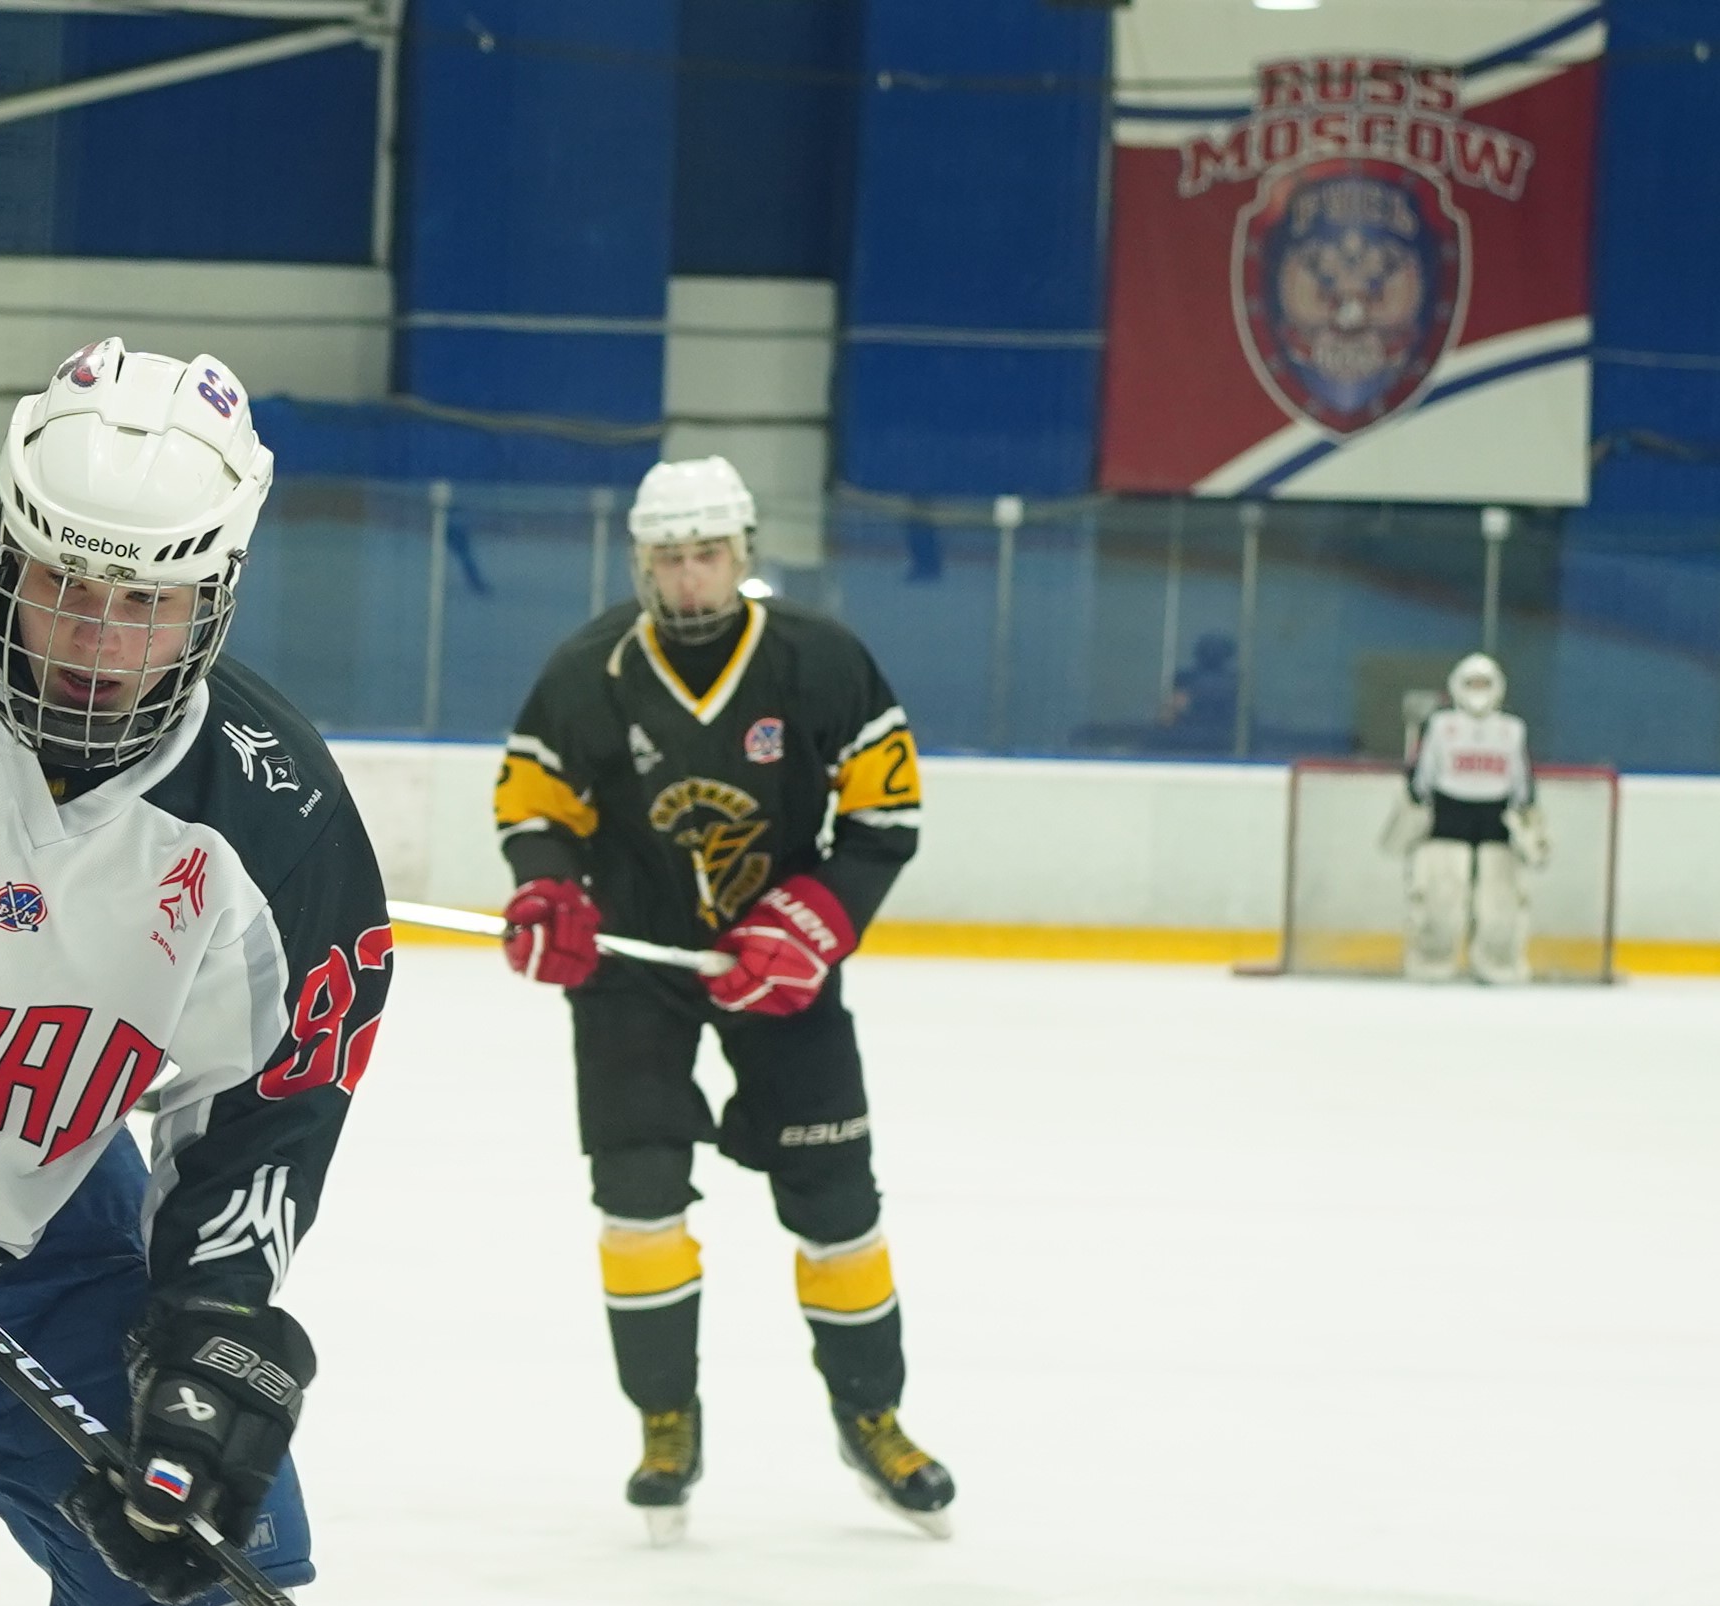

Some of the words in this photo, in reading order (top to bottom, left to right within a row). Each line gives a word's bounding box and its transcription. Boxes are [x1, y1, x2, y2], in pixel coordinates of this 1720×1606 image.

[1257, 58, 1464, 112] RUSS
[1178, 112, 1537, 200] MOSCOW
[60, 526, 142, 561] Reebok
[883, 740, 910, 795] 2
